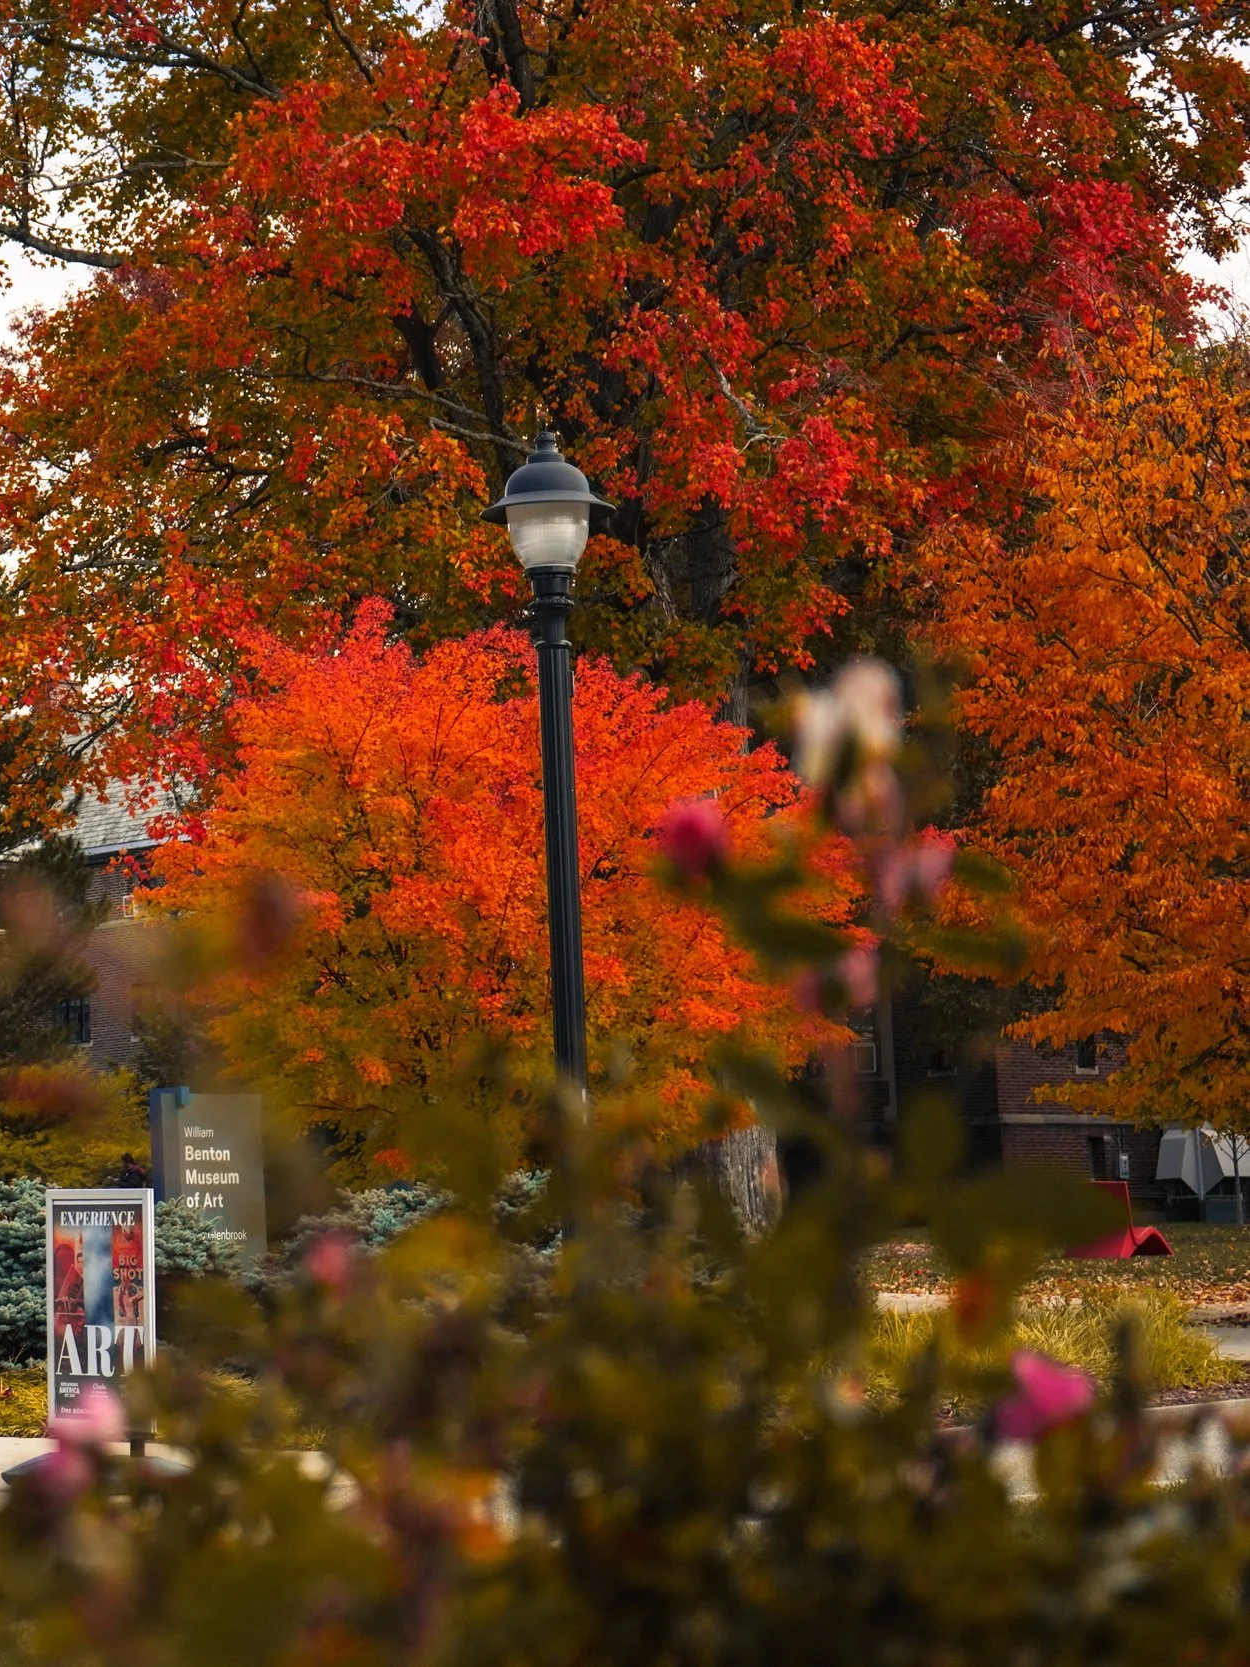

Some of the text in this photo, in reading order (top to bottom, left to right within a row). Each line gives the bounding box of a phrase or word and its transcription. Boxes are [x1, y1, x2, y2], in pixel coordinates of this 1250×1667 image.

[183, 1126, 215, 1138] William
[184, 1145, 230, 1161] Benton
[185, 1169, 240, 1185] Museum
[186, 1192, 224, 1208] of Art
[60, 1210, 136, 1227] EXPERIENCE
[118, 1255, 137, 1266] BIG
[113, 1268, 143, 1280] SHOT
[55, 1323, 144, 1378] ART
